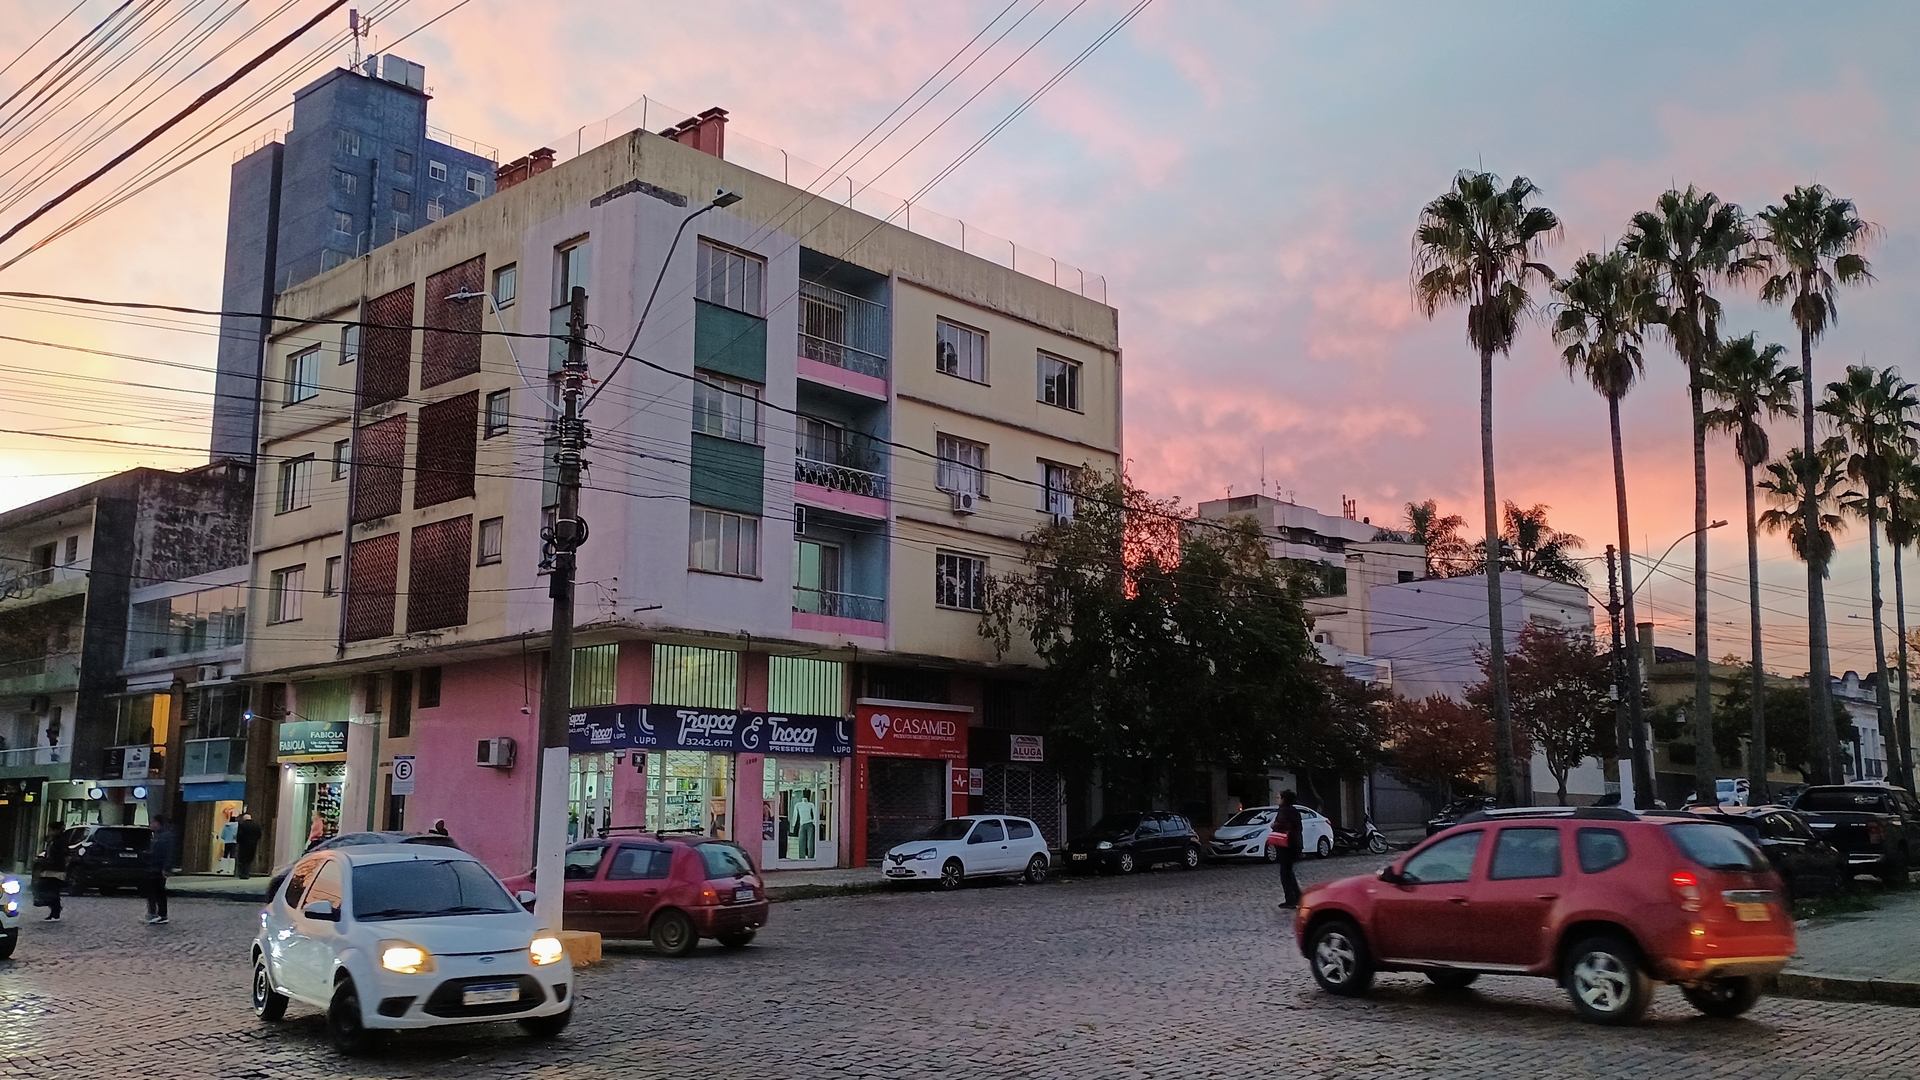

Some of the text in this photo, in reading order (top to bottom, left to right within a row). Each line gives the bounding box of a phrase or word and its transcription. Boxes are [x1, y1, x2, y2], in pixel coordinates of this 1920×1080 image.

[676, 709, 738, 745] Trapos
[893, 717, 956, 736] CASAMED
[310, 731, 345, 739] FABIOLA
[634, 736, 657, 745] LUPO
[279, 740, 306, 751] FABIOLA
[685, 737, 733, 748] 3242.6171
[769, 745, 815, 753] PRESENTES
[1013, 747, 1042, 757] ALUGA
[400, 764, 408, 776] E
